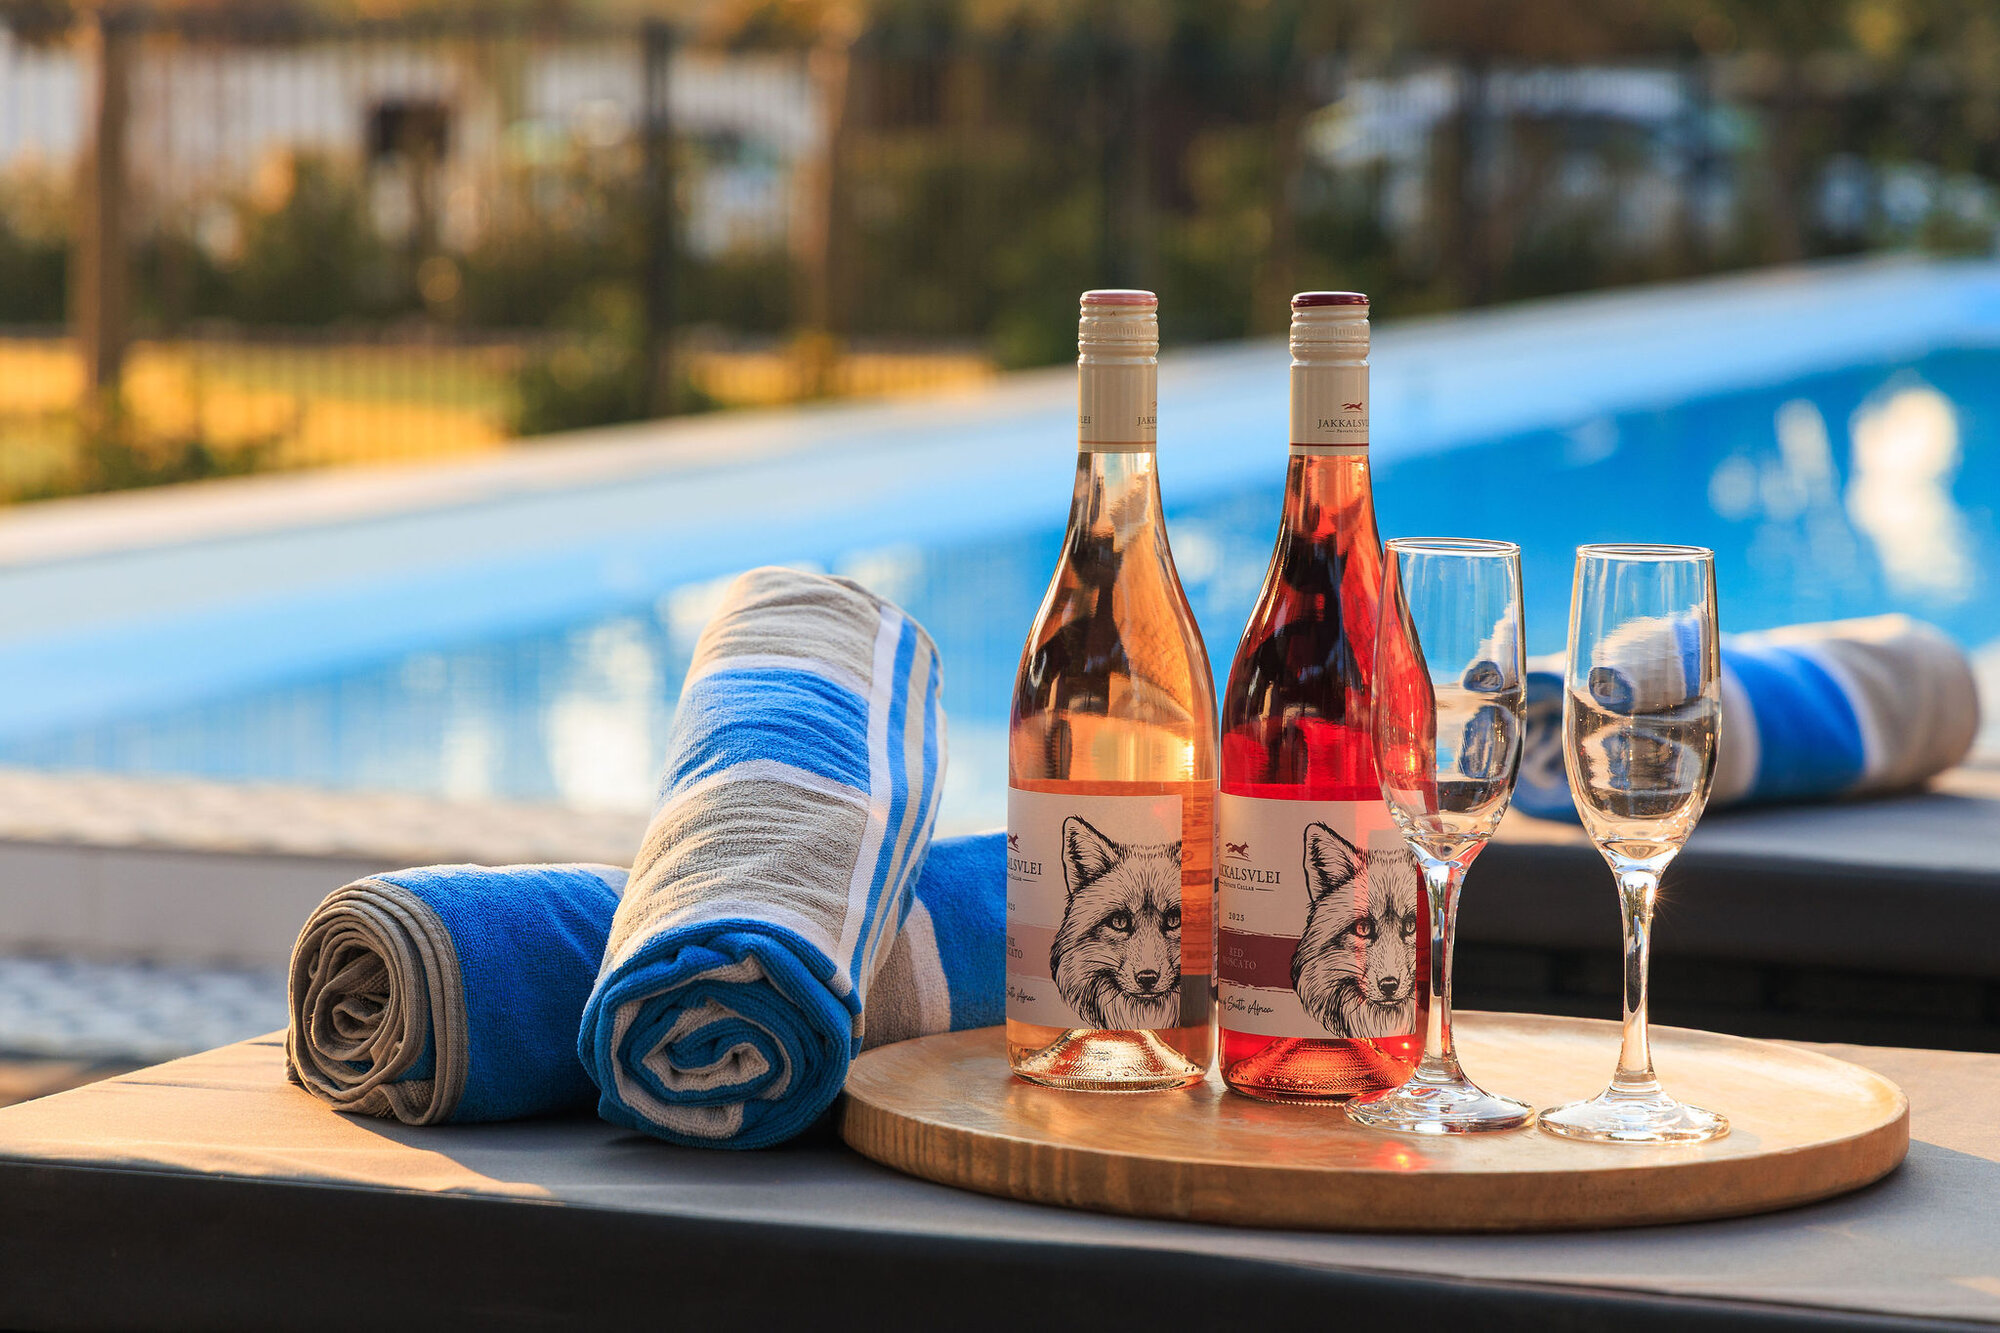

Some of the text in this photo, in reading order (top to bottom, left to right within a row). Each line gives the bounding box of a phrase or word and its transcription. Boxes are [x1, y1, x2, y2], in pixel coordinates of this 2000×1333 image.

[1228, 911, 1245, 922] 2025
[1227, 995, 1246, 1012] South
[1247, 999, 1275, 1016] Africa
